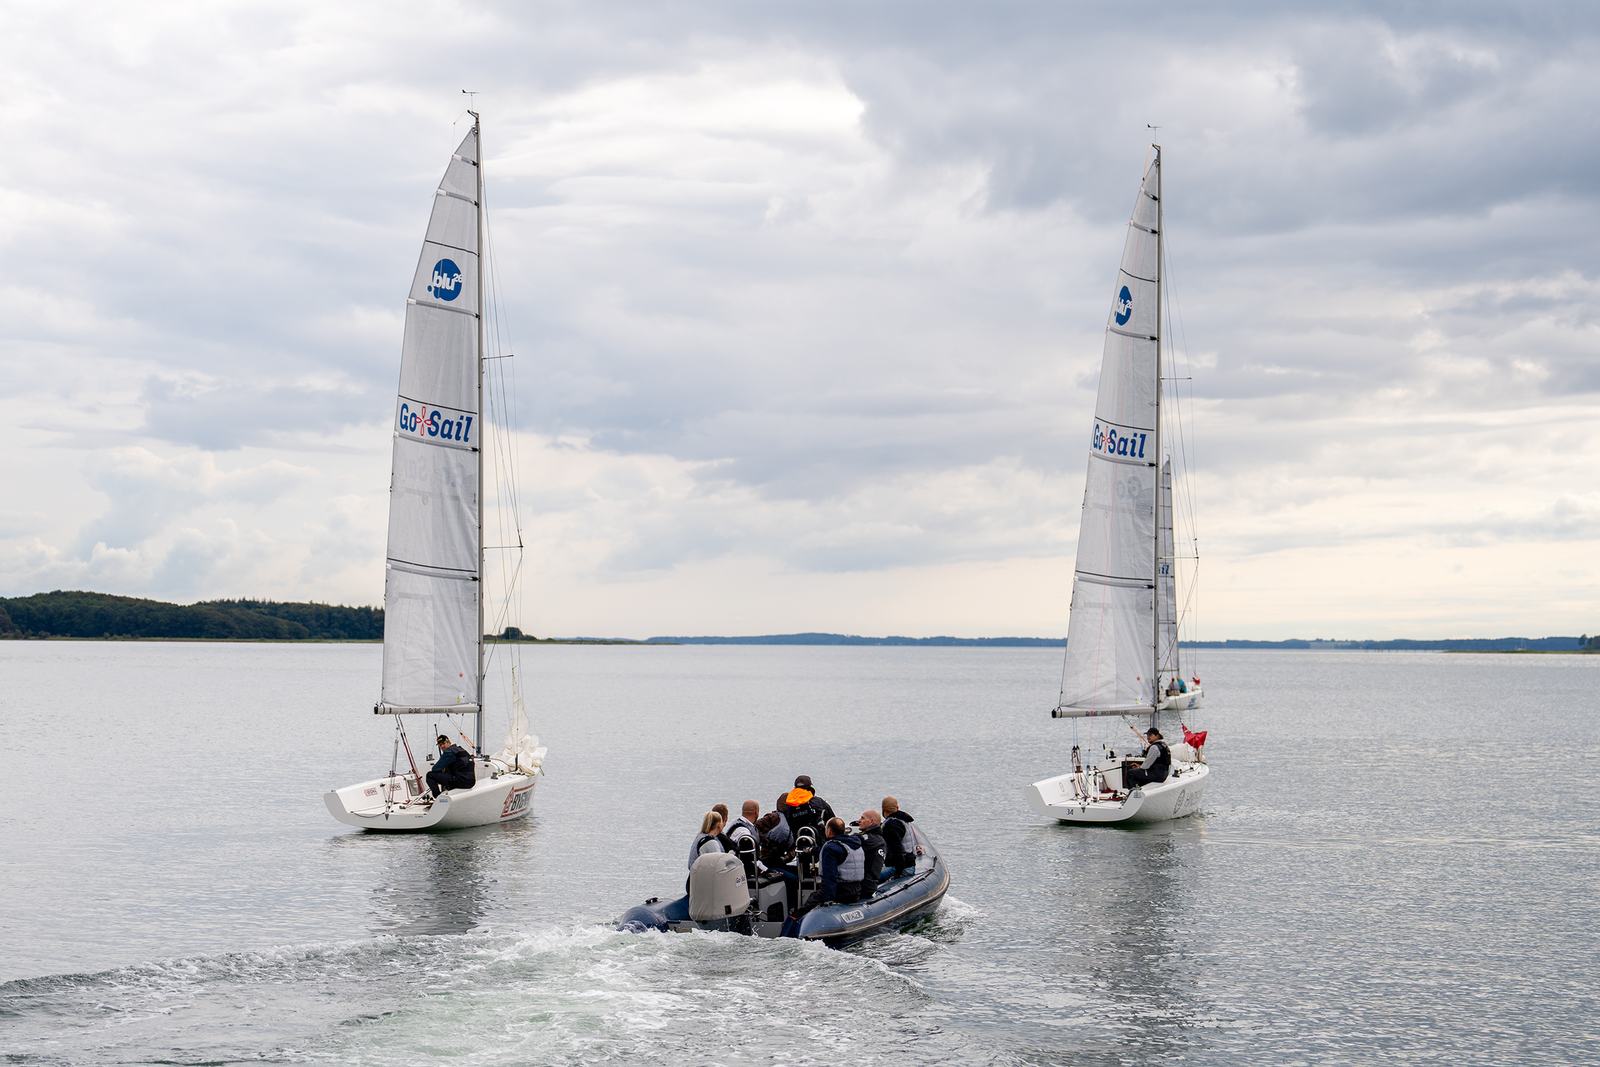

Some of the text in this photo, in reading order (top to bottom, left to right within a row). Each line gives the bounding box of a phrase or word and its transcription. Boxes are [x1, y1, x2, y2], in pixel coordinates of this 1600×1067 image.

[400, 403, 472, 443] Go Sail
[1093, 424, 1146, 458] Go Sail
